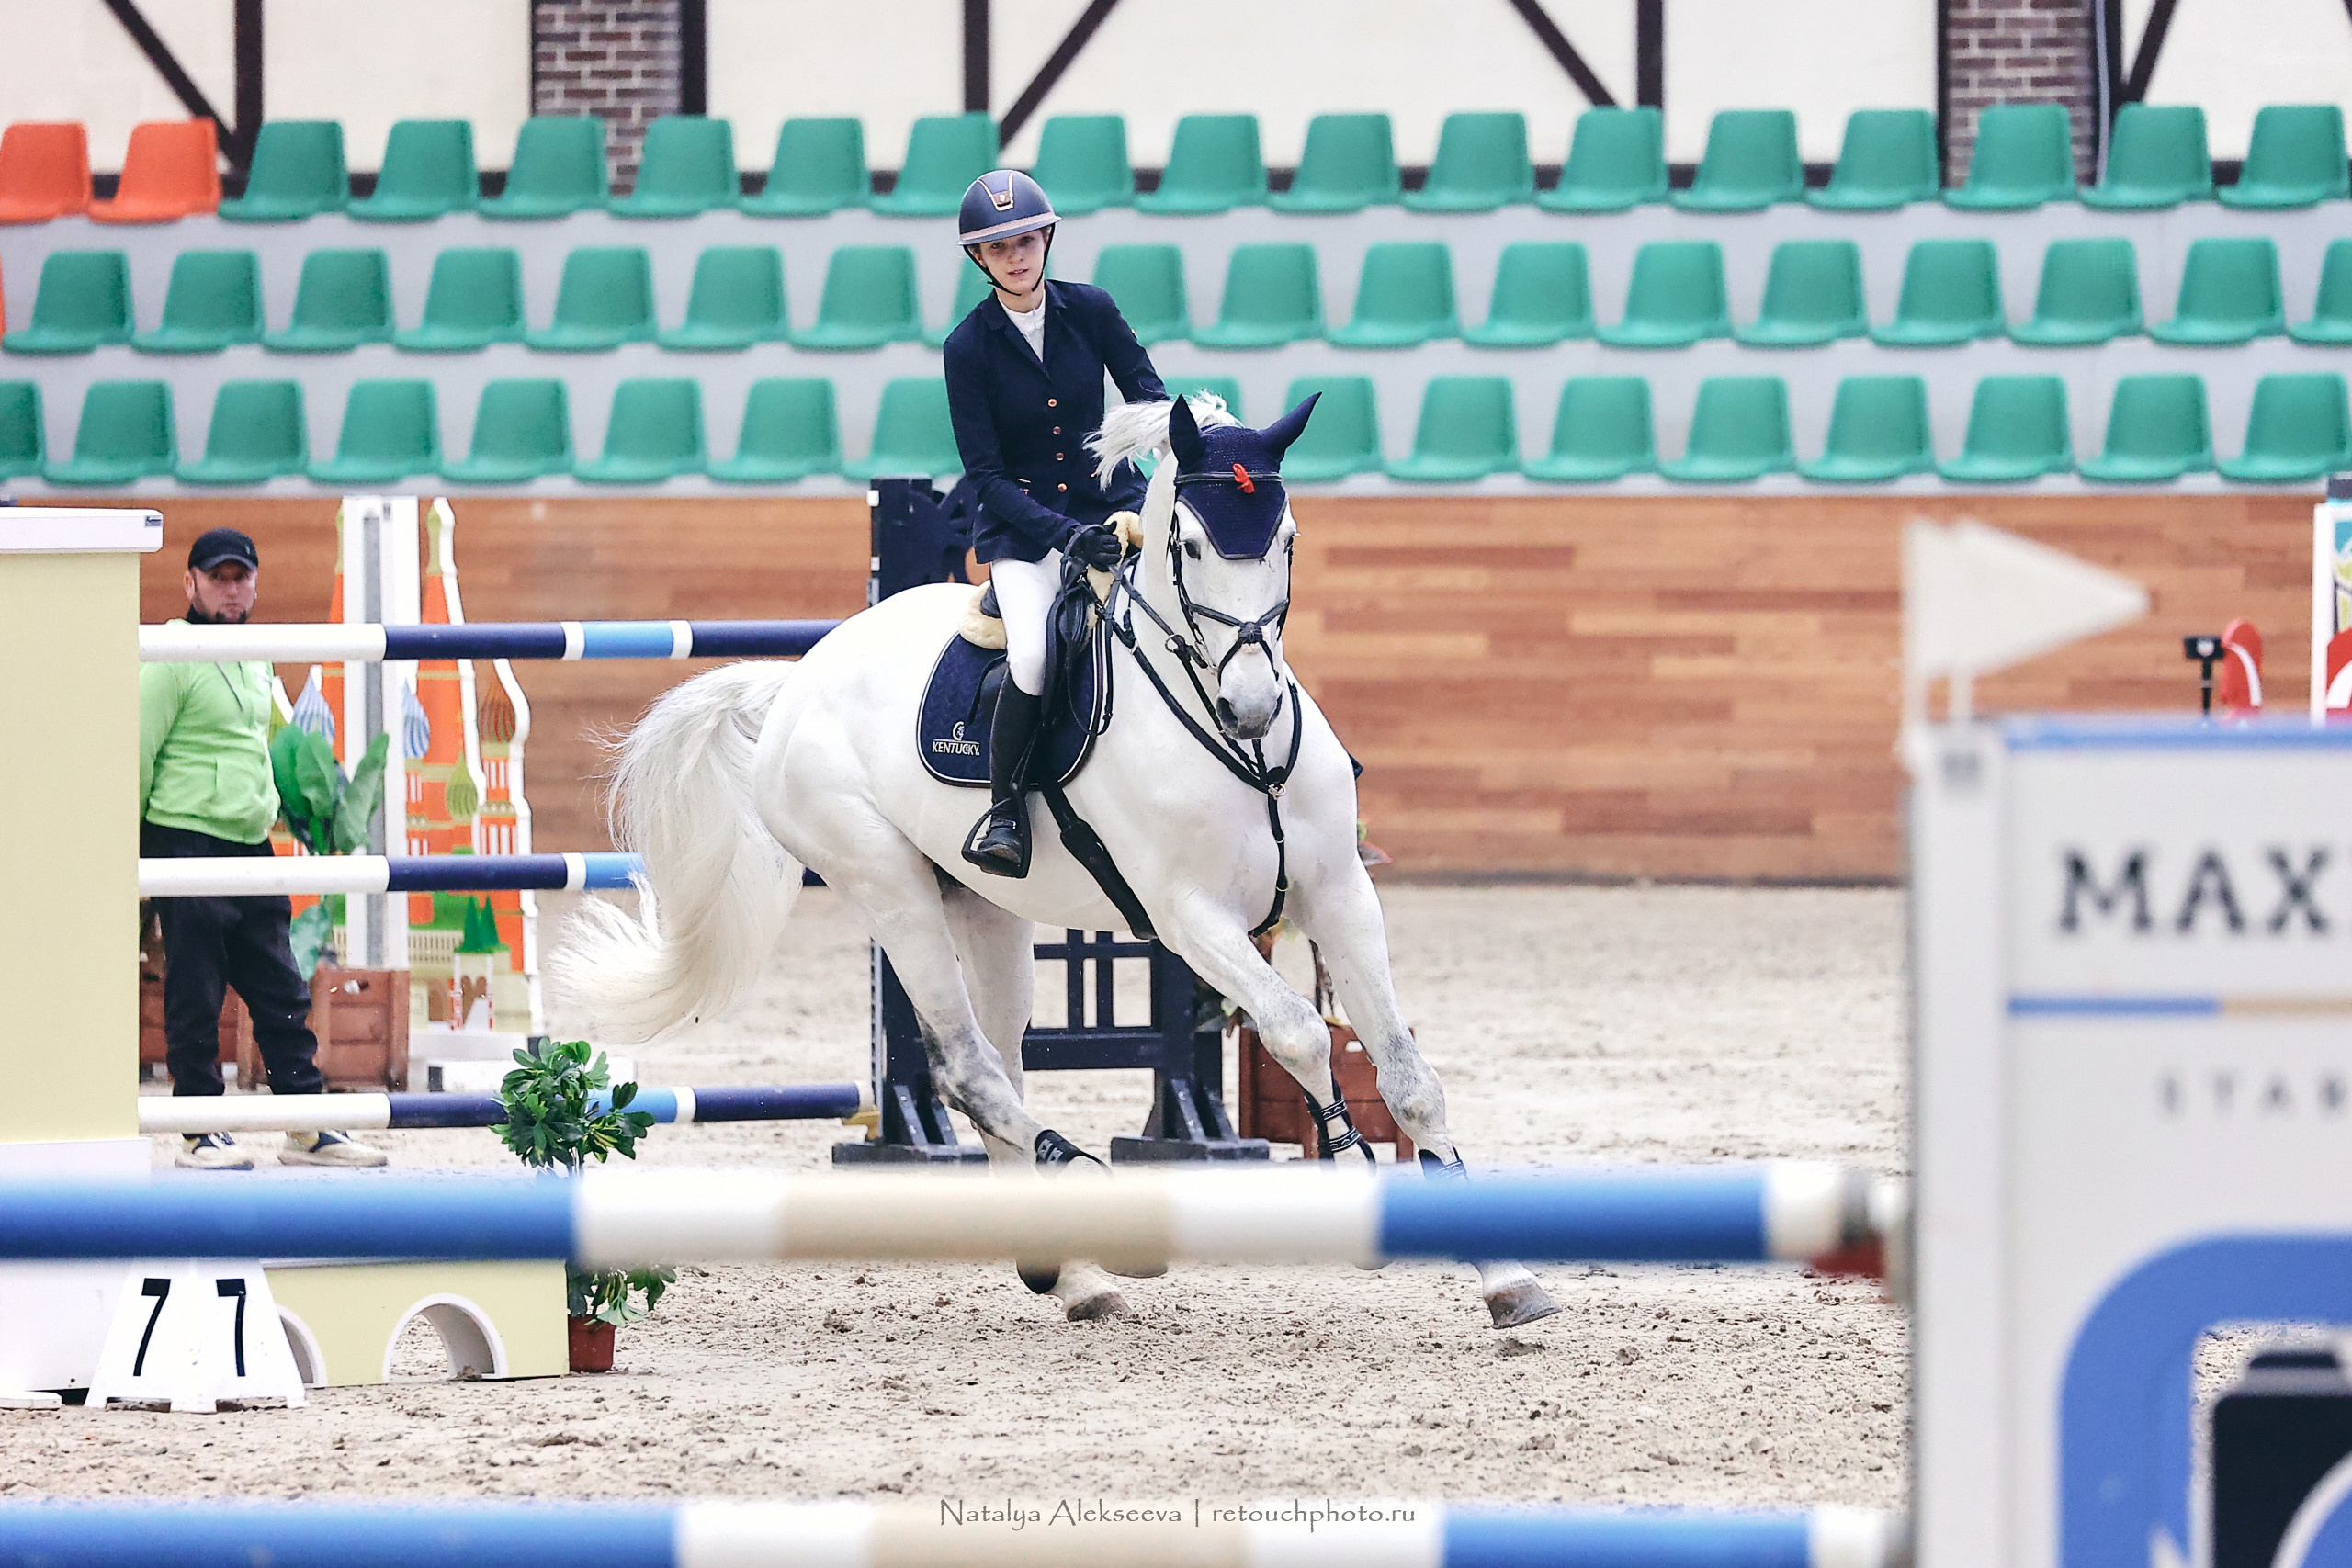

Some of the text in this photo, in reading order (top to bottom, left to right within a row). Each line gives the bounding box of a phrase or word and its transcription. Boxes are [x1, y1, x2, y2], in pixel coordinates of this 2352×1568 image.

[932, 740, 980, 756] KENTUCKY
[133, 1278, 171, 1377] 7
[216, 1278, 246, 1377] 7
